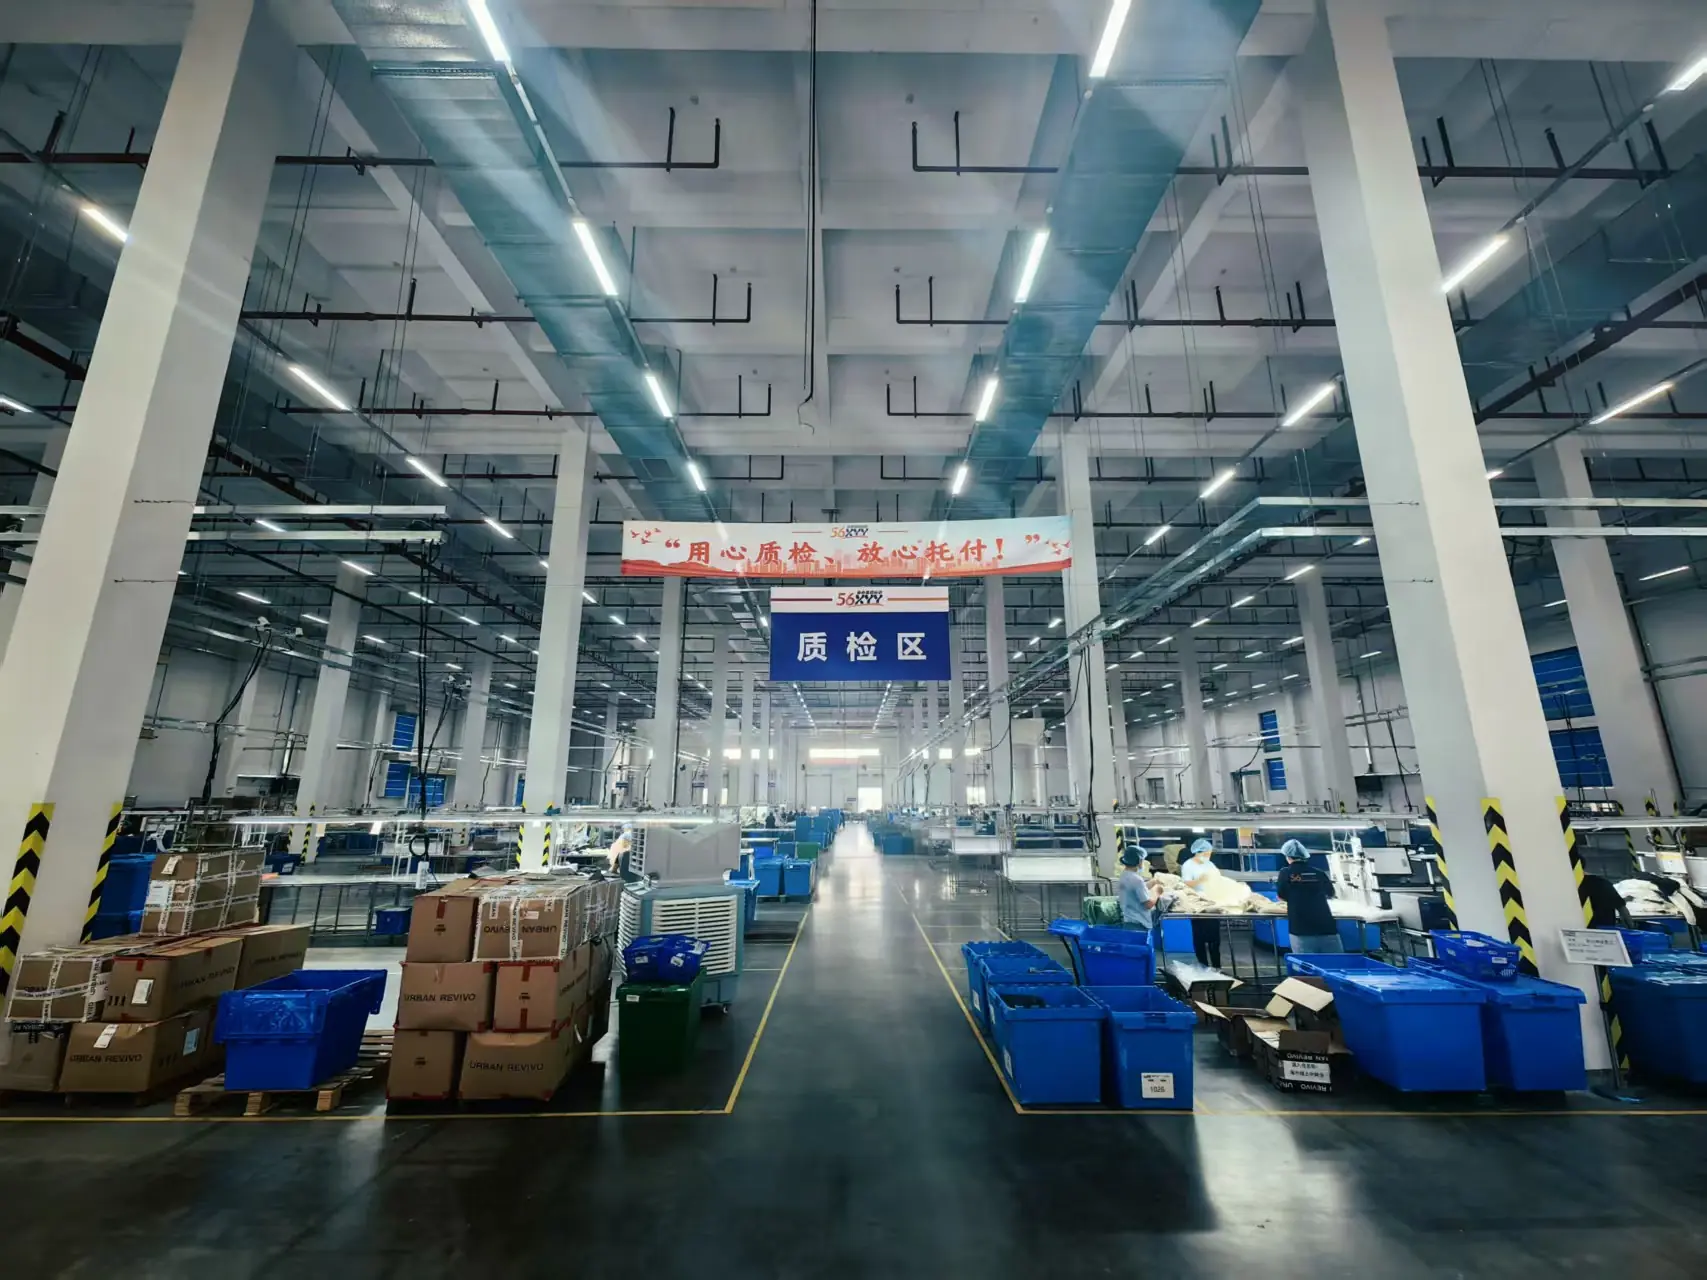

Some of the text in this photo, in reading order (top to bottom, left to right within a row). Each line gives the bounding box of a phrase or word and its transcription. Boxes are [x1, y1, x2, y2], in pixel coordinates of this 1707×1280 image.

[797, 631, 927, 662] 质检区
[484, 925, 510, 933] EVIVO
[404, 993, 476, 1001] URBAN REVIVO
[469, 1062, 544, 1071] URBAN REVIVO
